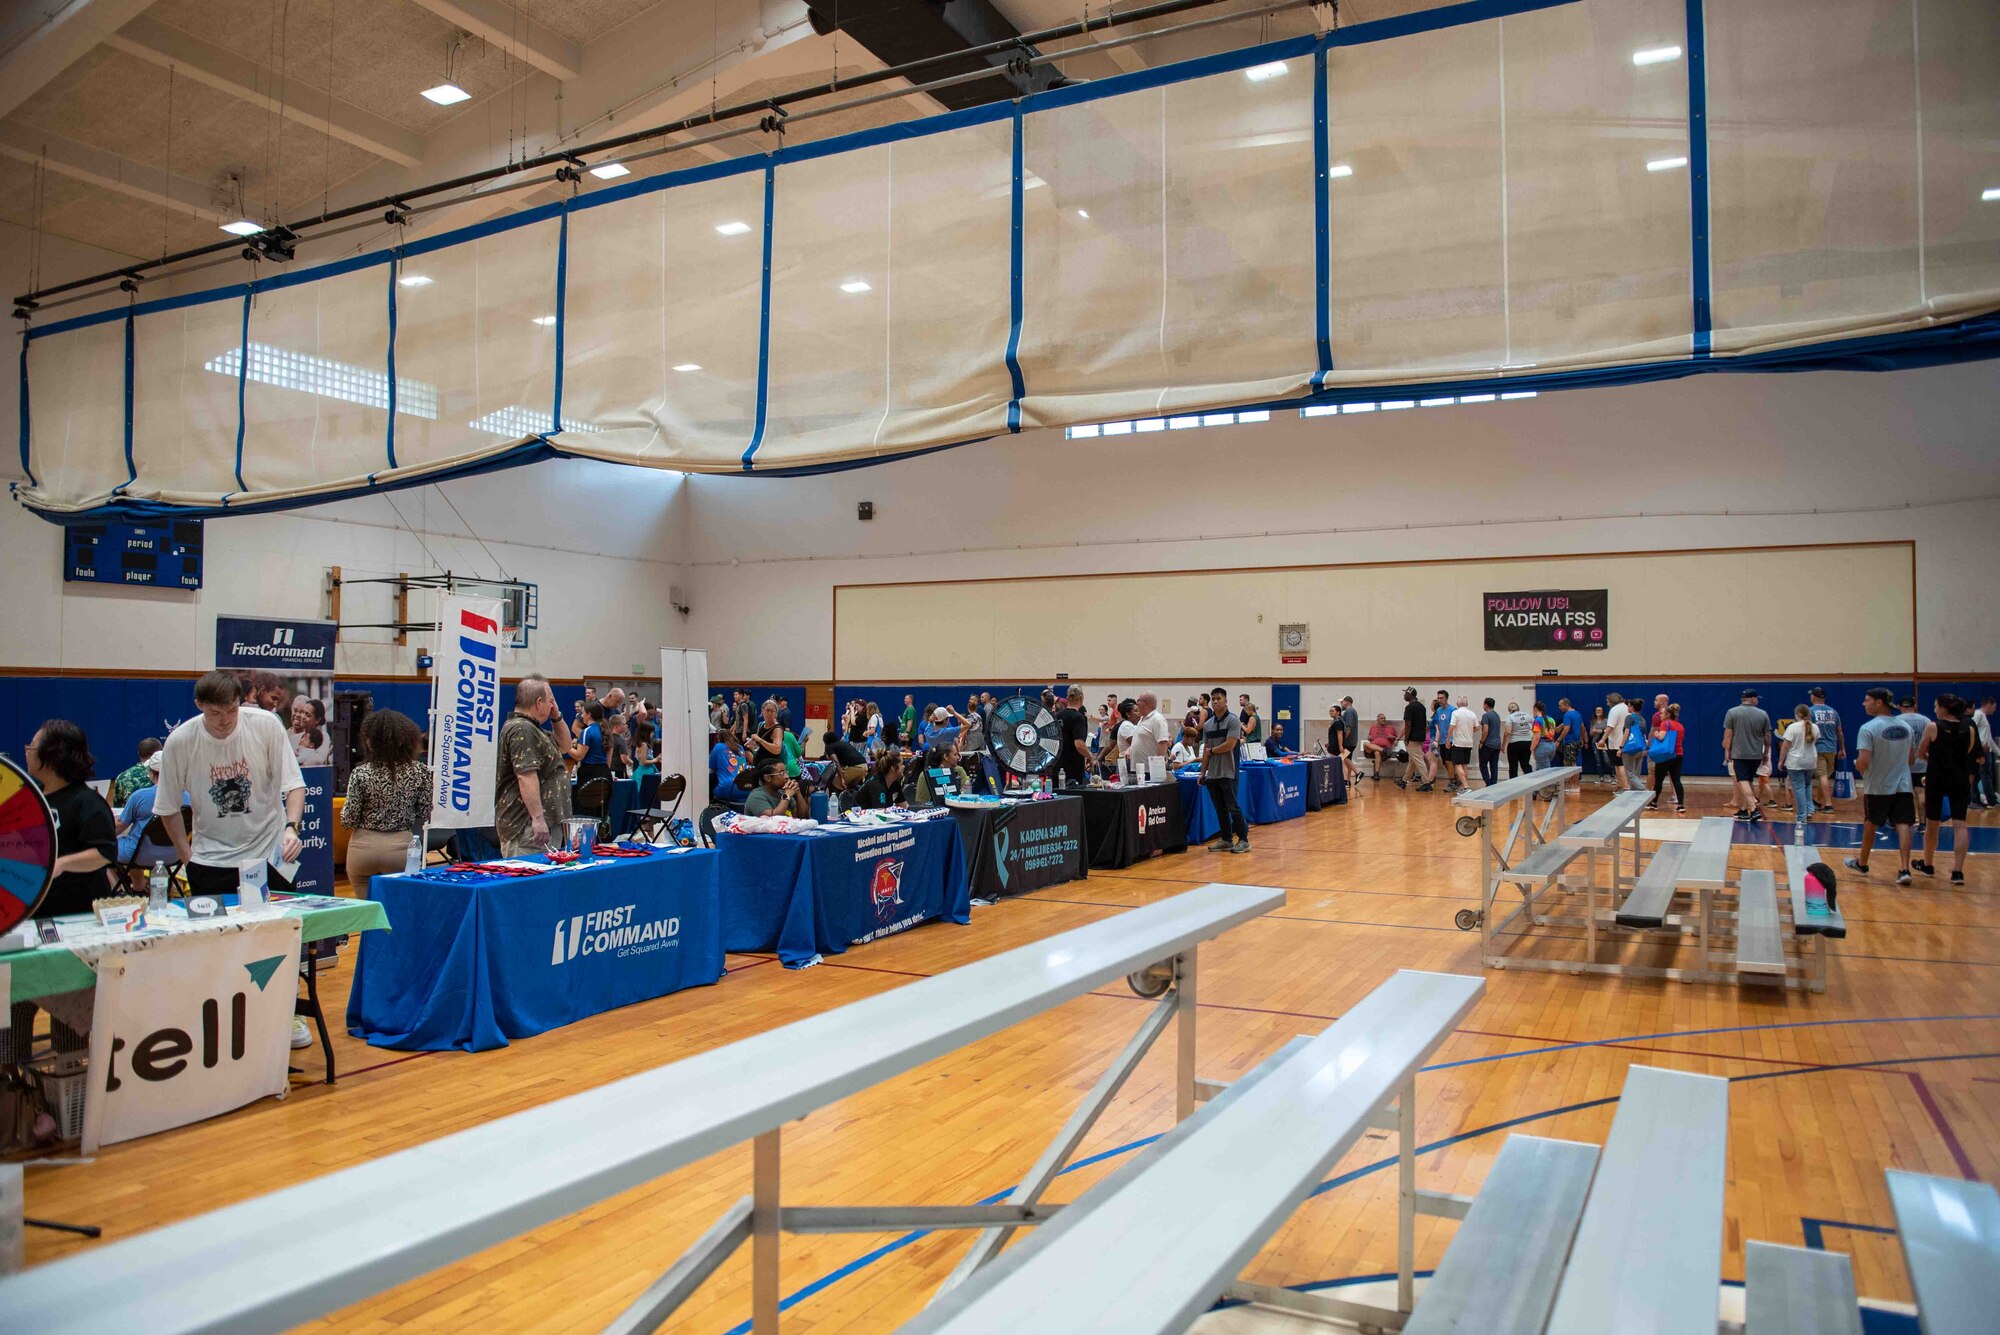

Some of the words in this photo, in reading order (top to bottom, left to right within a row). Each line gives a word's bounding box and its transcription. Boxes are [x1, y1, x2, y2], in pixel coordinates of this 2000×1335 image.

[127, 539, 154, 549] period
[75, 567, 96, 578] fouls
[126, 571, 152, 581] player
[181, 576, 199, 586] fouls
[1487, 597, 1542, 611] FOLLOW
[1546, 596, 1569, 610] US!
[1494, 612, 1561, 627] KADENA
[1565, 611, 1596, 626] FSS
[232, 643, 325, 658] FirstCommand
[475, 664, 496, 742] FIRST
[445, 714, 454, 735] Get
[451, 658, 476, 812] COMMAND
[441, 735, 453, 778] Squared
[437, 779, 450, 809] Away
[304, 802, 315, 813] in
[1148, 806, 1167, 816] American
[308, 818, 320, 830] of
[1148, 816, 1156, 825] Red
[1155, 815, 1166, 824] Cross
[857, 835, 876, 849] Alcohol
[876, 833, 886, 844] and
[886, 831, 898, 840] Drug
[1020, 827, 1049, 843] KADENA
[1049, 825, 1068, 838] SAPR
[855, 847, 882, 862] Prevention
[882, 844, 892, 855] and
[892, 837, 916, 852] Treatment
[1026, 844, 1050, 858] HOTLINE
[585, 904, 636, 934] FIRST
[582, 917, 680, 956] COMMAND
[617, 947, 630, 958] Get
[630, 942, 660, 955] Squared
[661, 938, 680, 951] Away
